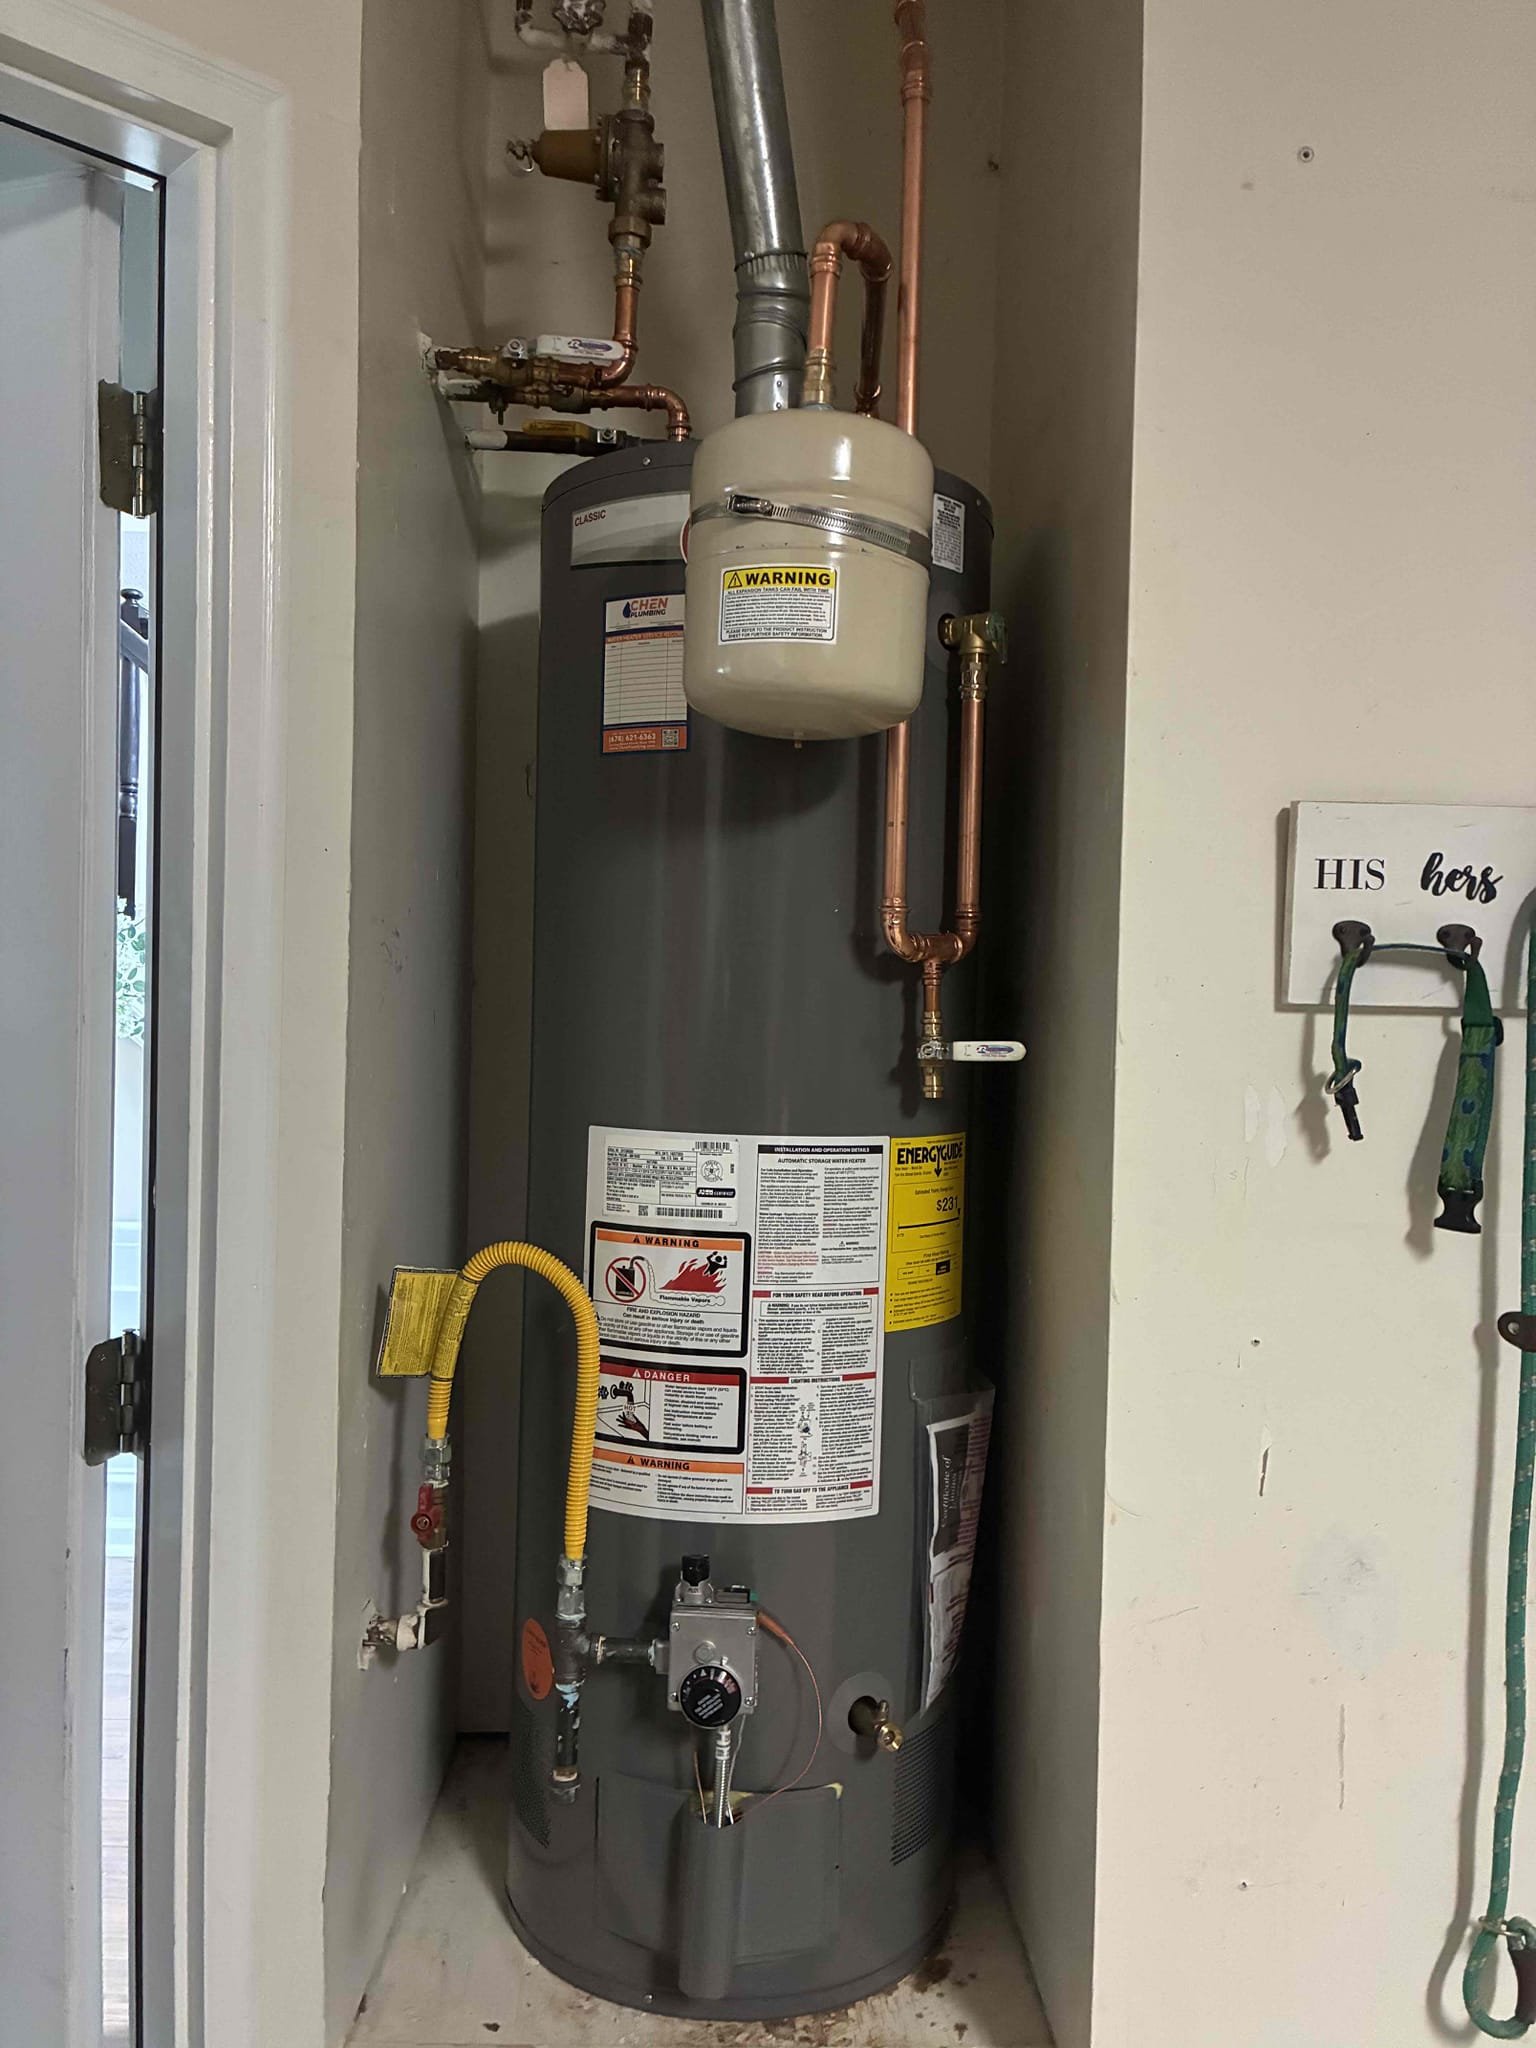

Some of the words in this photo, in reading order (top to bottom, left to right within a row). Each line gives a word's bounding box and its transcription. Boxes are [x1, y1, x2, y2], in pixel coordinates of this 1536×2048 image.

[574, 509, 607, 527] CLASSIC
[745, 572, 831, 586] WARNING
[630, 597, 669, 611] CHEN
[630, 609, 666, 618] PLUMBING
[1313, 858, 1385, 891] HIS
[1420, 852, 1504, 904] hers
[936, 1196, 958, 1212] $231
[645, 1235, 700, 1248] WARNING
[660, 1294, 690, 1303] Flammable
[691, 1296, 711, 1304] Vapors
[644, 1370, 691, 1382] DANGER
[640, 1457, 690, 1470] WARNING
